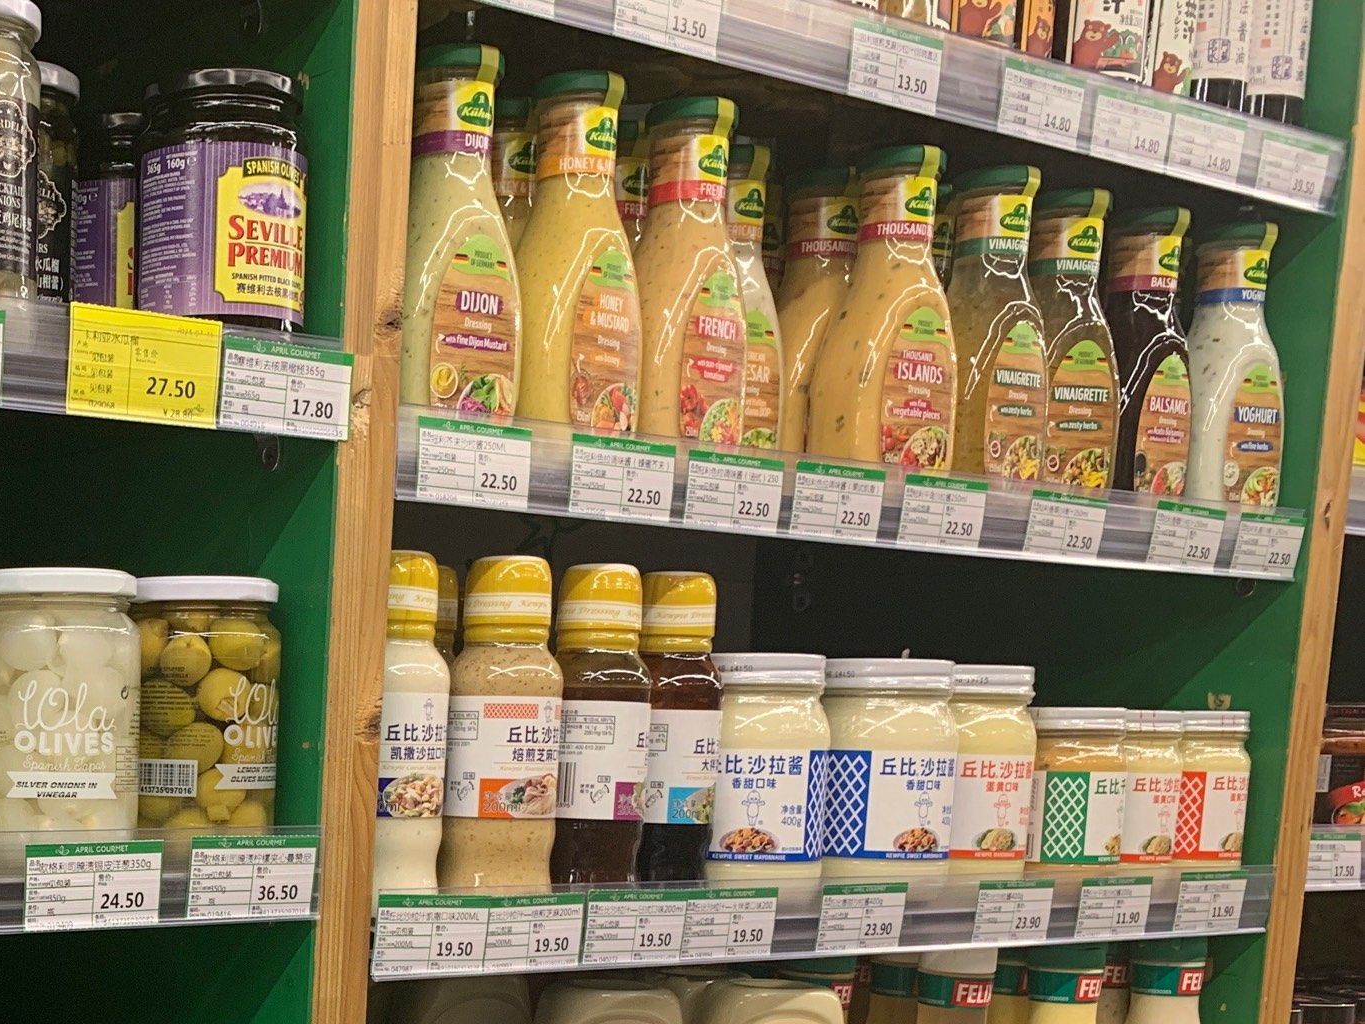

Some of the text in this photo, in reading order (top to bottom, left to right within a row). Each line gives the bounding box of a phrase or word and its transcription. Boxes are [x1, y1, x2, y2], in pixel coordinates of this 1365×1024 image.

[228, 214, 303, 244] SEVILLE
[227, 242, 303, 279] PREMIUM
[461, 291, 500, 315] DIJON
[897, 362, 943, 384] ISLANDS
[146, 376, 196, 399] 27.50
[1054, 386, 1109, 403] VINAIGRETTE
[291, 398, 333, 420] 17.80
[1237, 407, 1278, 424] YOGHURT
[480, 471, 518, 492] 22.50
[627, 488, 661, 506] 22.50
[738, 499, 770, 519] 22.50
[841, 510, 871, 527] 22.50
[14, 730, 116, 756] OLIVES
[16, 781, 98, 791] SILVER ONIONS IN
[732, 778, 777, 790] 香甜口味
[905, 779, 941, 791] 香甜口味
[36, 791, 78, 800] VINEGAR
[100, 891, 144, 910] 24.50
[257, 884, 298, 901] 36.50
[1211, 905, 1235, 918] 11.90
[863, 922, 893, 937] 23.90
[1015, 915, 1041, 929] 23.90
[535, 936, 570, 954] 19.50
[638, 931, 673, 949] 19.50
[436, 940, 474, 959] 19.50
